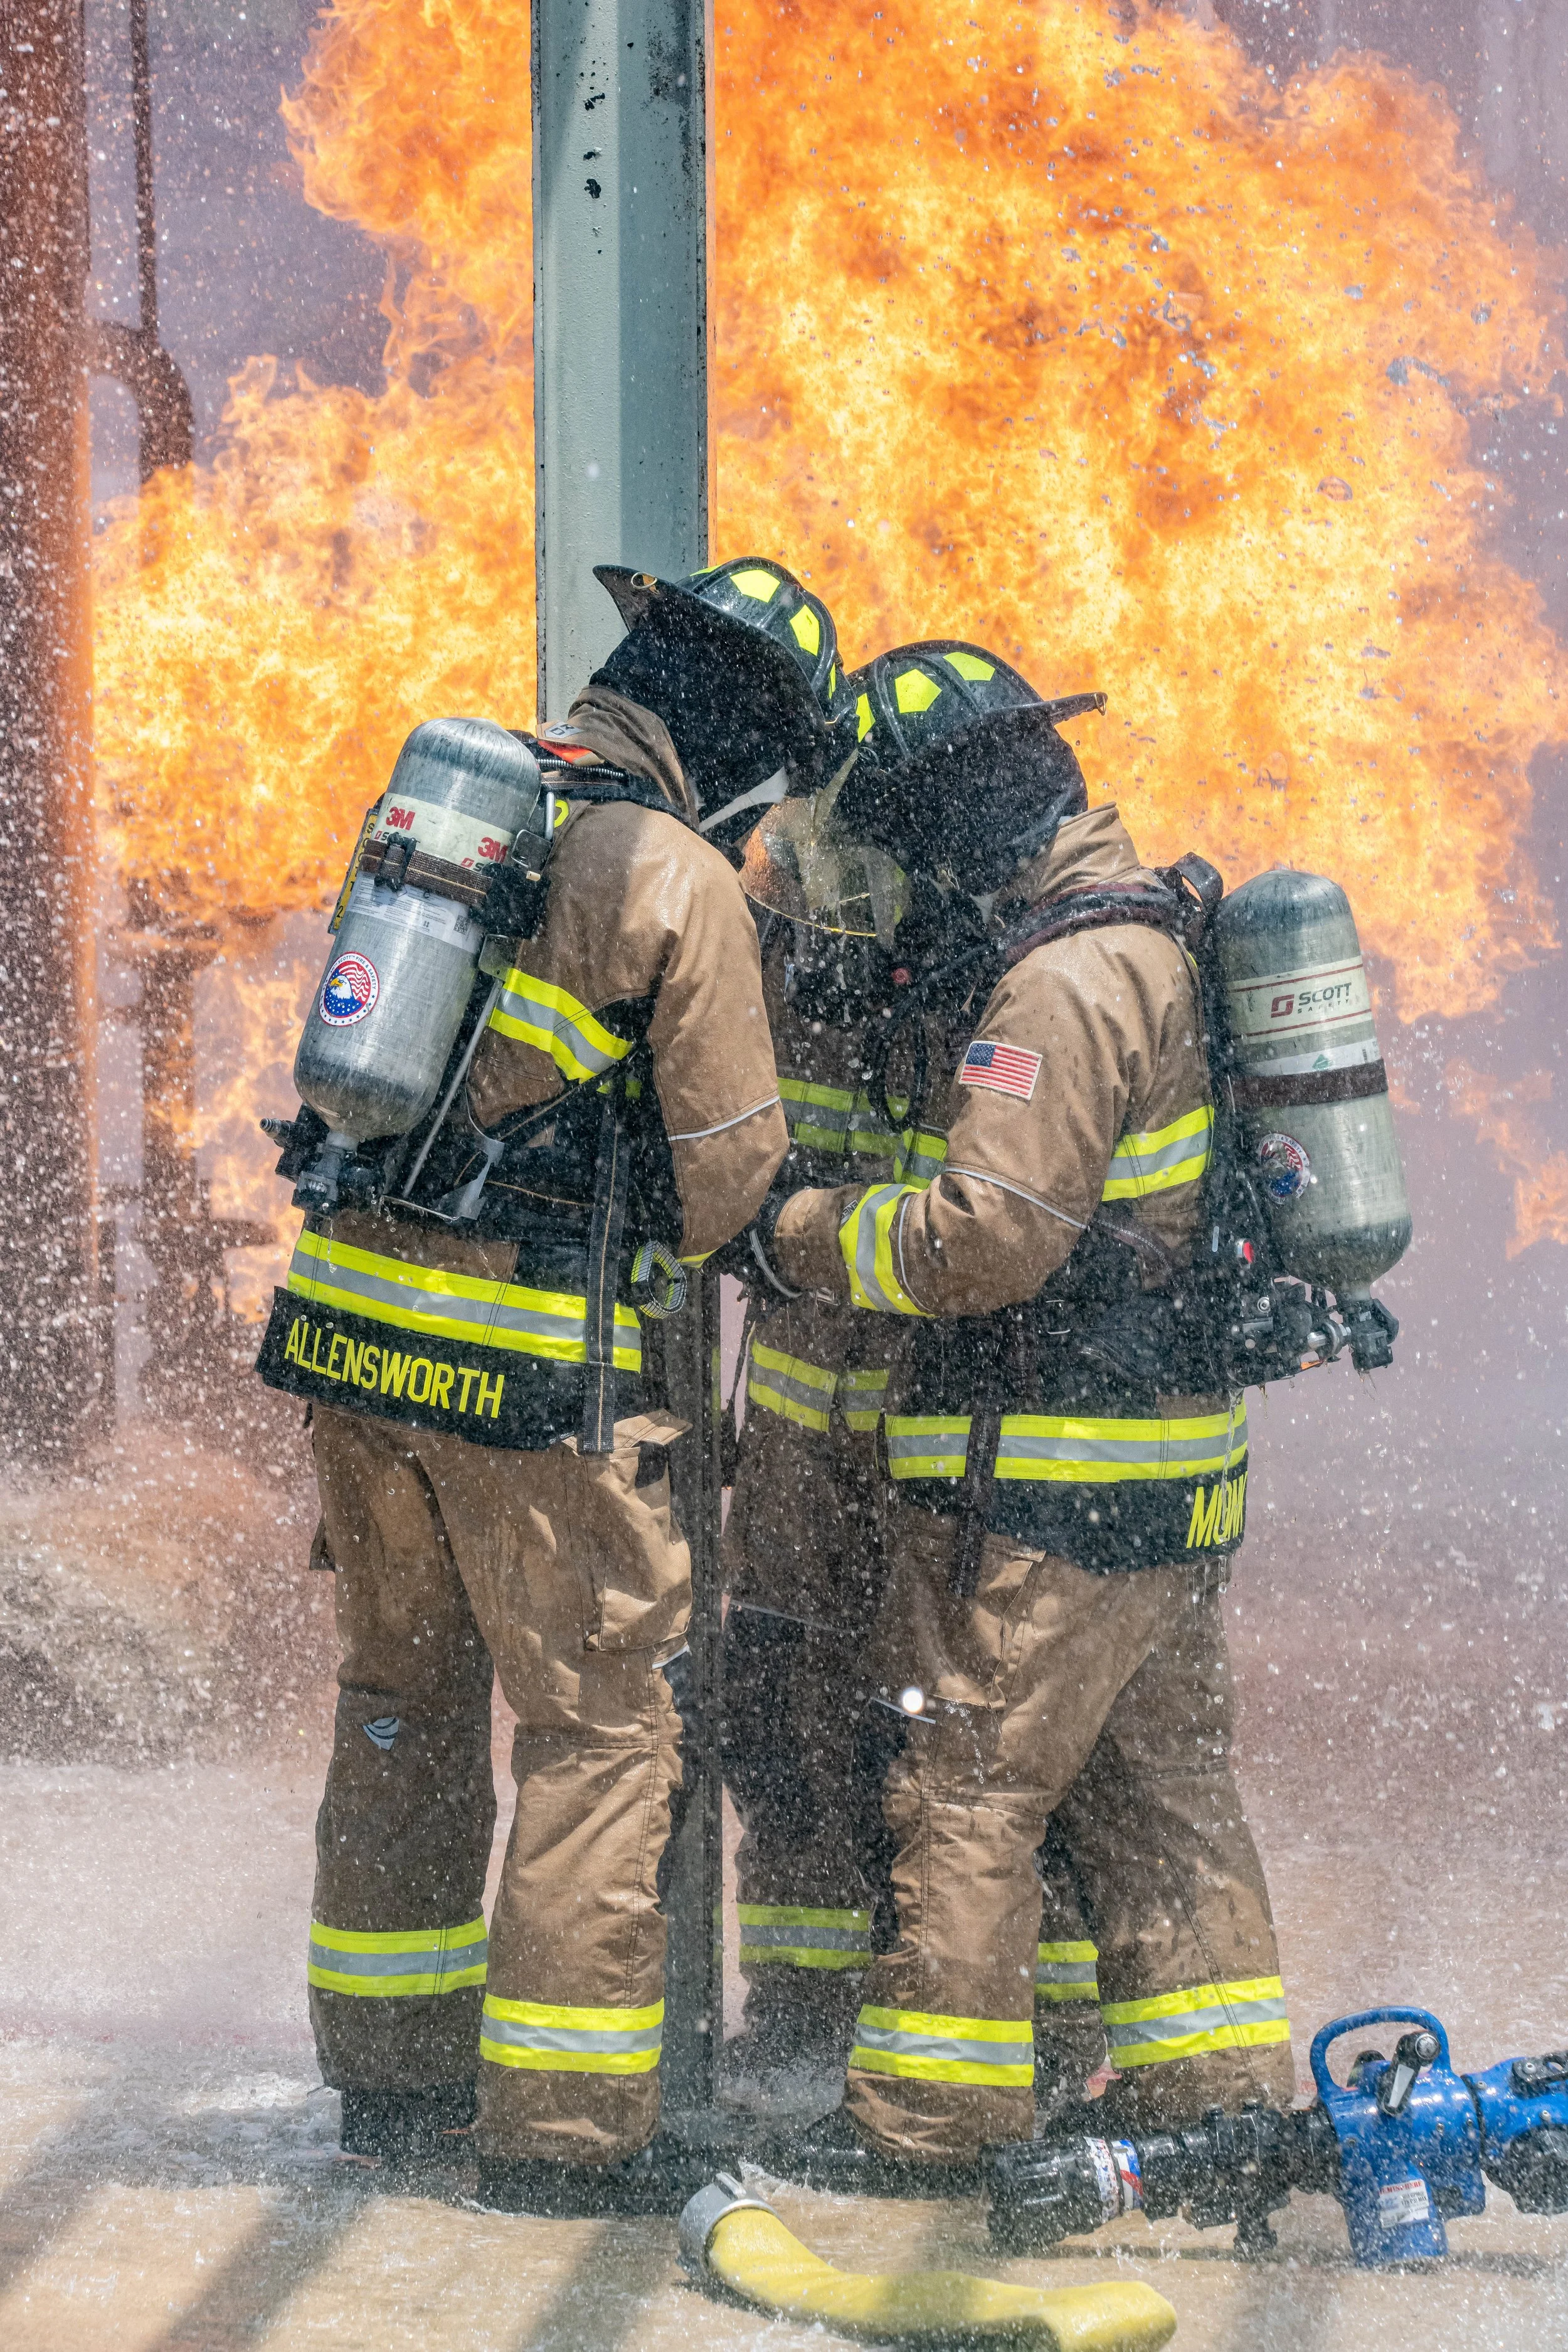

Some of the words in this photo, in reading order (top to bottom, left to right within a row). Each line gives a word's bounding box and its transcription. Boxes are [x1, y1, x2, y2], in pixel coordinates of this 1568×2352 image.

[386, 807, 415, 831] 3M
[478, 837, 508, 864] 3M
[356, 956, 366, 965] FIRE
[368, 968, 376, 990] SAFETY
[1299, 982, 1352, 1006] SCOTT
[284, 1318, 504, 1419] ALLENSWORTH
